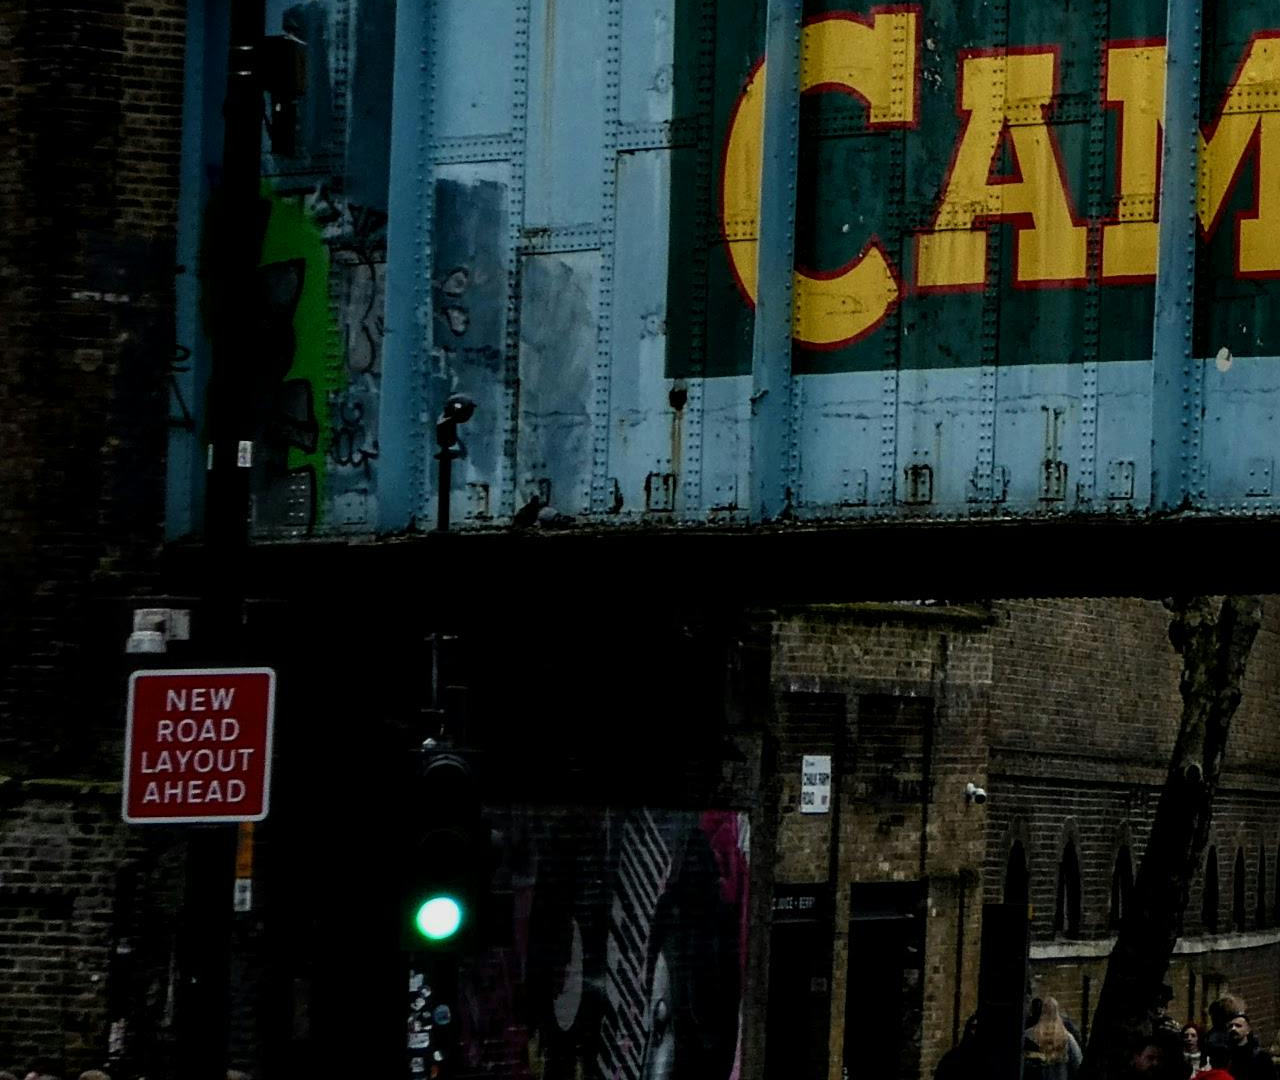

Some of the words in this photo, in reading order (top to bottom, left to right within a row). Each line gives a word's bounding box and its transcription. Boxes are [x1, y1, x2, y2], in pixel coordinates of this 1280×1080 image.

[165, 688, 235, 712] NEW
[156, 718, 241, 743] ROAD
[141, 748, 255, 774] LAYOUT
[141, 778, 247, 804] AHEAD
